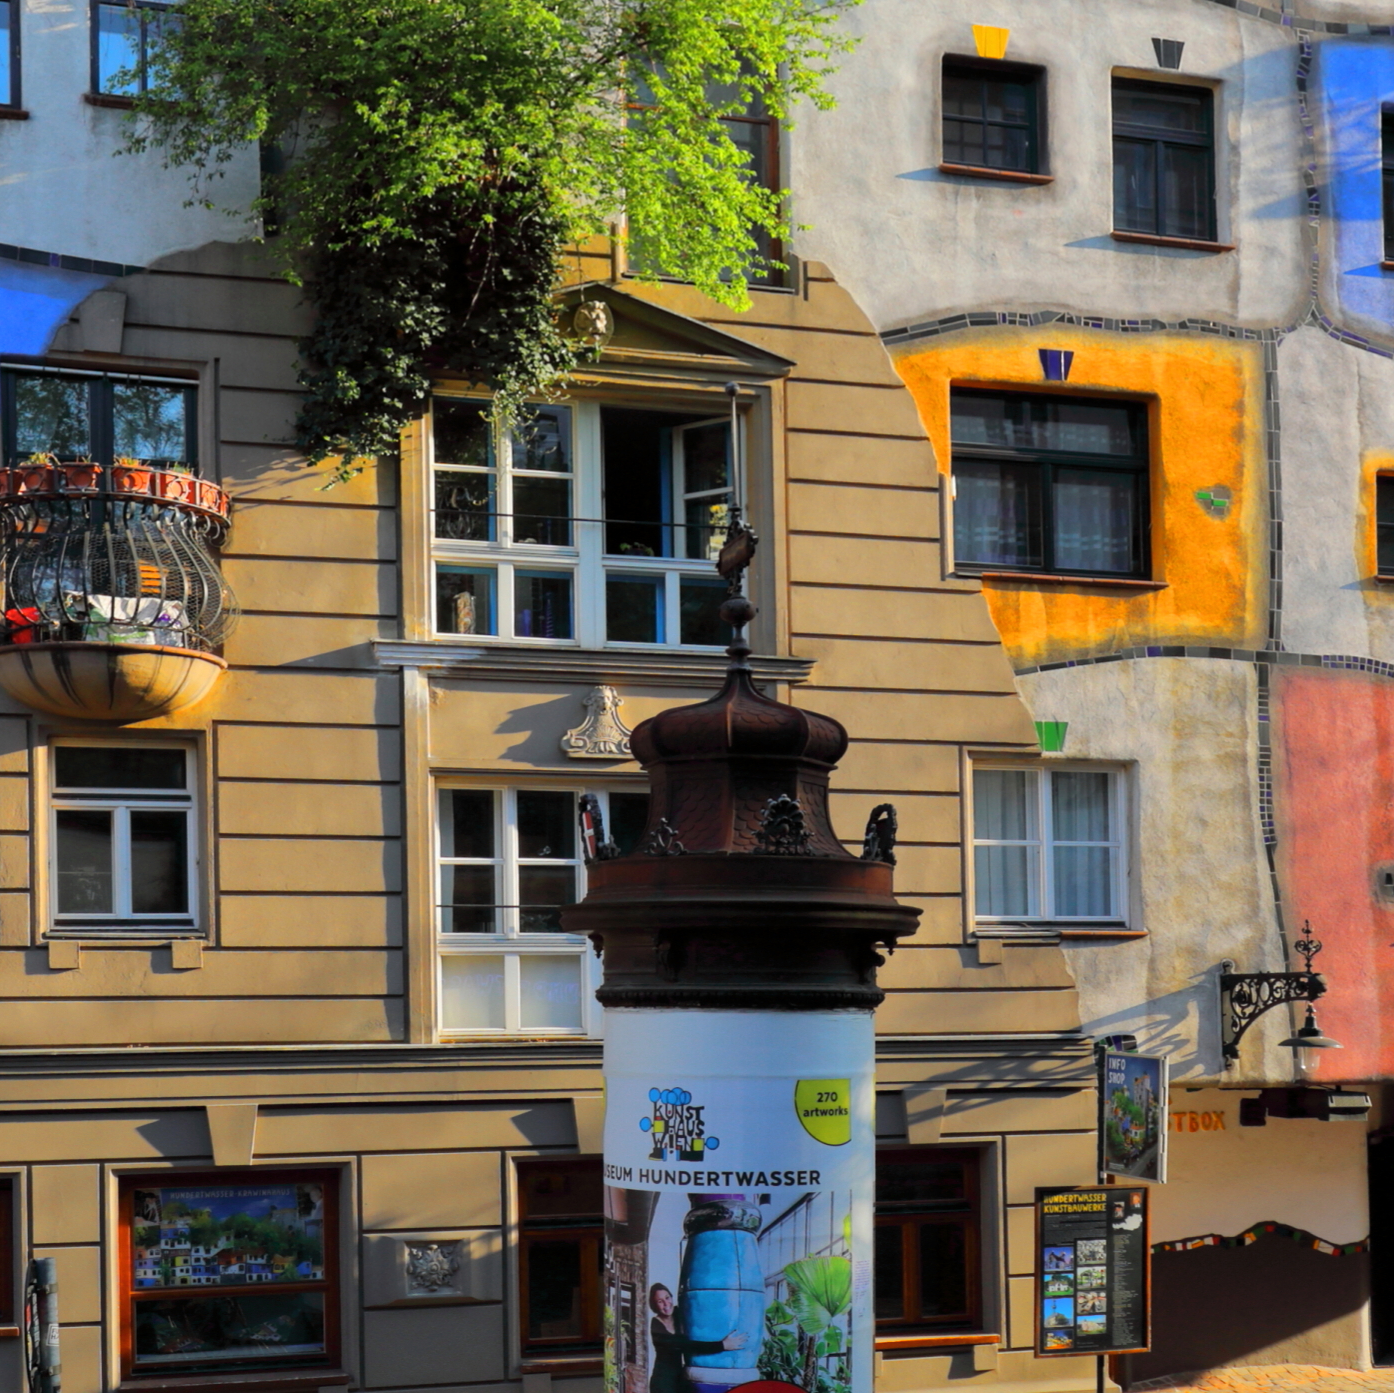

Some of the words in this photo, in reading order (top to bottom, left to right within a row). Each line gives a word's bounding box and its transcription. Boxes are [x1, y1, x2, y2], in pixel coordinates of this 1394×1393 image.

[1109, 1057, 1126, 1070] INFO
[1108, 1071, 1125, 1085] SHOP
[817, 1092, 838, 1103] 270
[653, 1101, 705, 1123] KUNST
[803, 1106, 848, 1117] artworks
[1168, 1111, 1226, 1133] TBOX
[639, 1168, 821, 1187] HUNDERTWASSER
